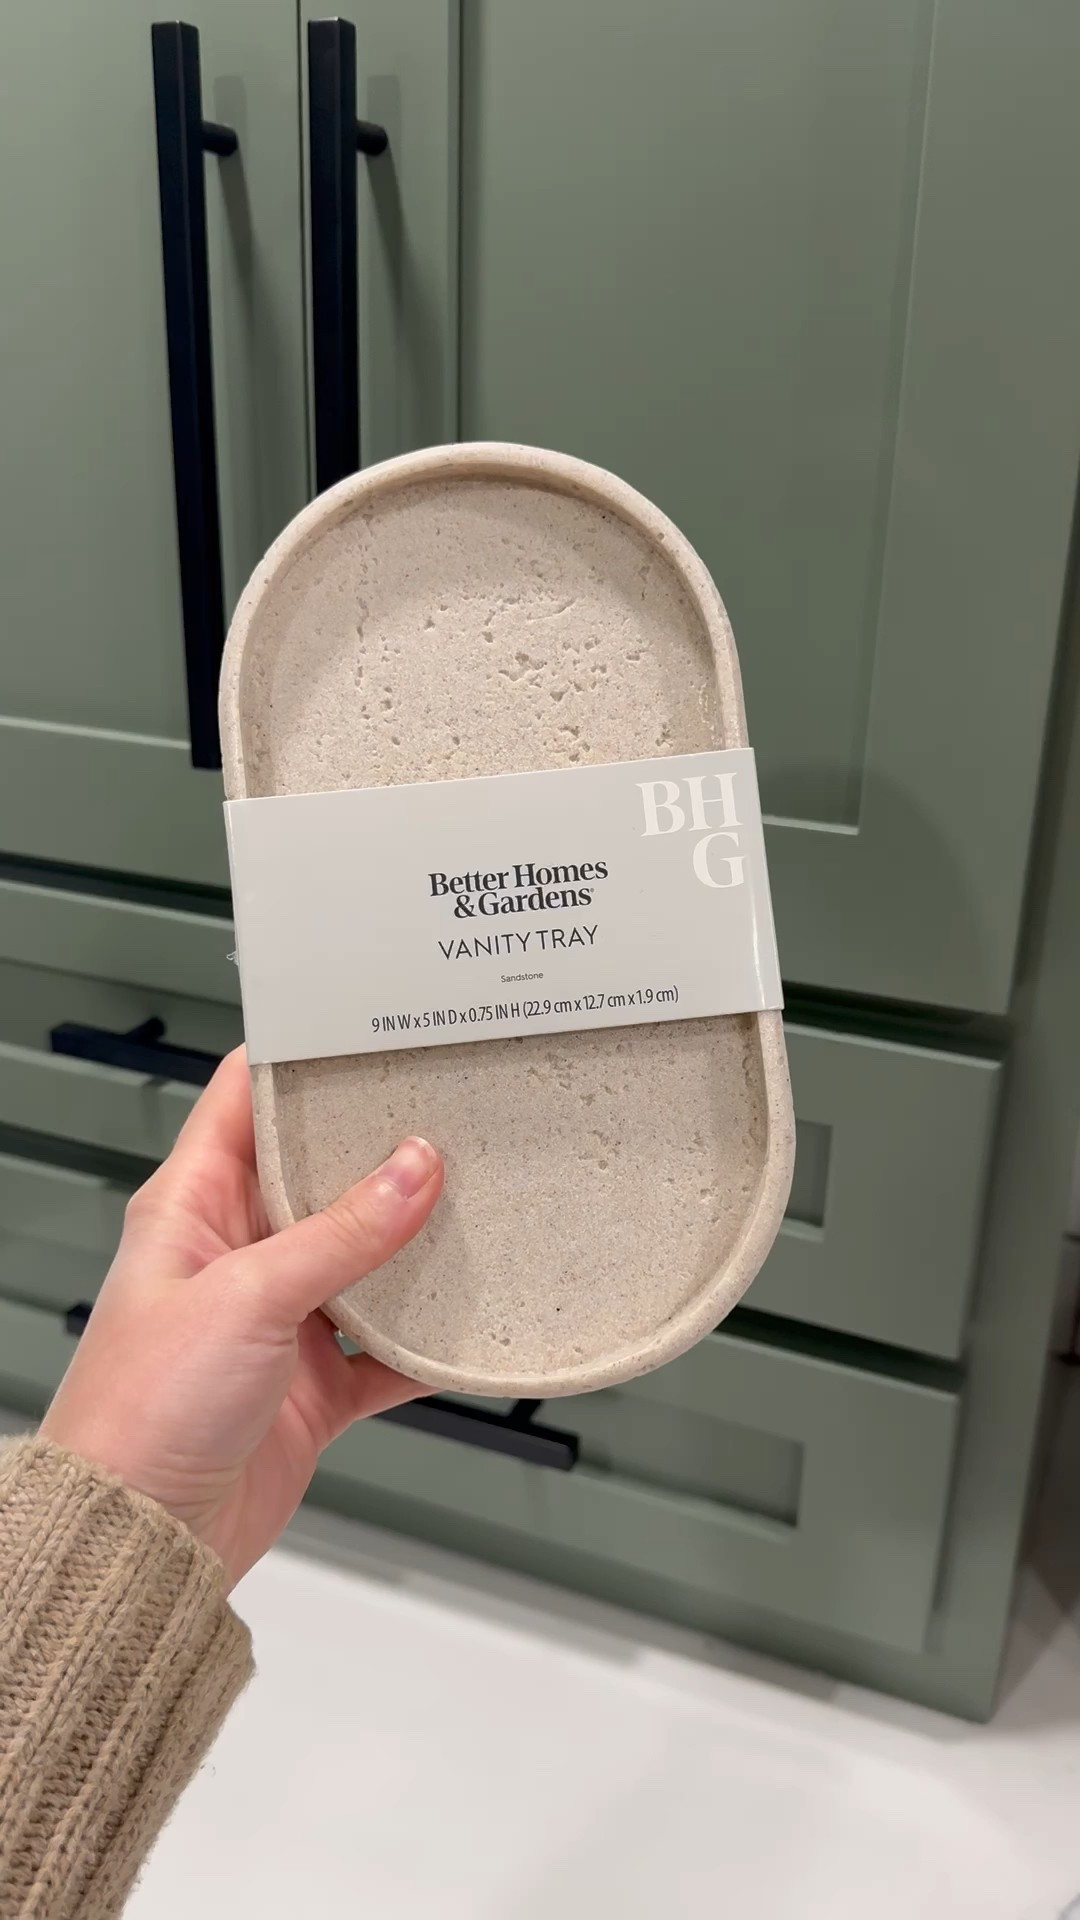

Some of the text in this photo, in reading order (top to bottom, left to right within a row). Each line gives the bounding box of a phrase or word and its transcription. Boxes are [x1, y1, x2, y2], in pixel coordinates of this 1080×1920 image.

[635, 772, 744, 837] BH
[428, 861, 608, 896] Better Homes
[692, 831, 746, 888] G
[438, 924, 598, 960] VANITY TRAY
[500, 971, 544, 984] Sandstone
[371, 1017, 380, 1033] 9
[382, 1015, 396, 1032] IN
[397, 1013, 411, 1030] W
[413, 1016, 422, 1029] x
[423, 1012, 431, 1028] 5
[432, 1010, 446, 1027] IN
[448, 1009, 457, 1025] D
[459, 1012, 468, 1024] x
[468, 1006, 493, 1023] 0.75
[495, 1003, 508, 1020] IN
[510, 1002, 521, 1019] H
[523, 1000, 552, 1020] (22.9
[553, 1000, 573, 1014] cm
[583, 993, 605, 1011] 12.7
[607, 994, 626, 1008] cm
[635, 988, 654, 1005] 1.9
[655, 984, 679, 1004] cm)
